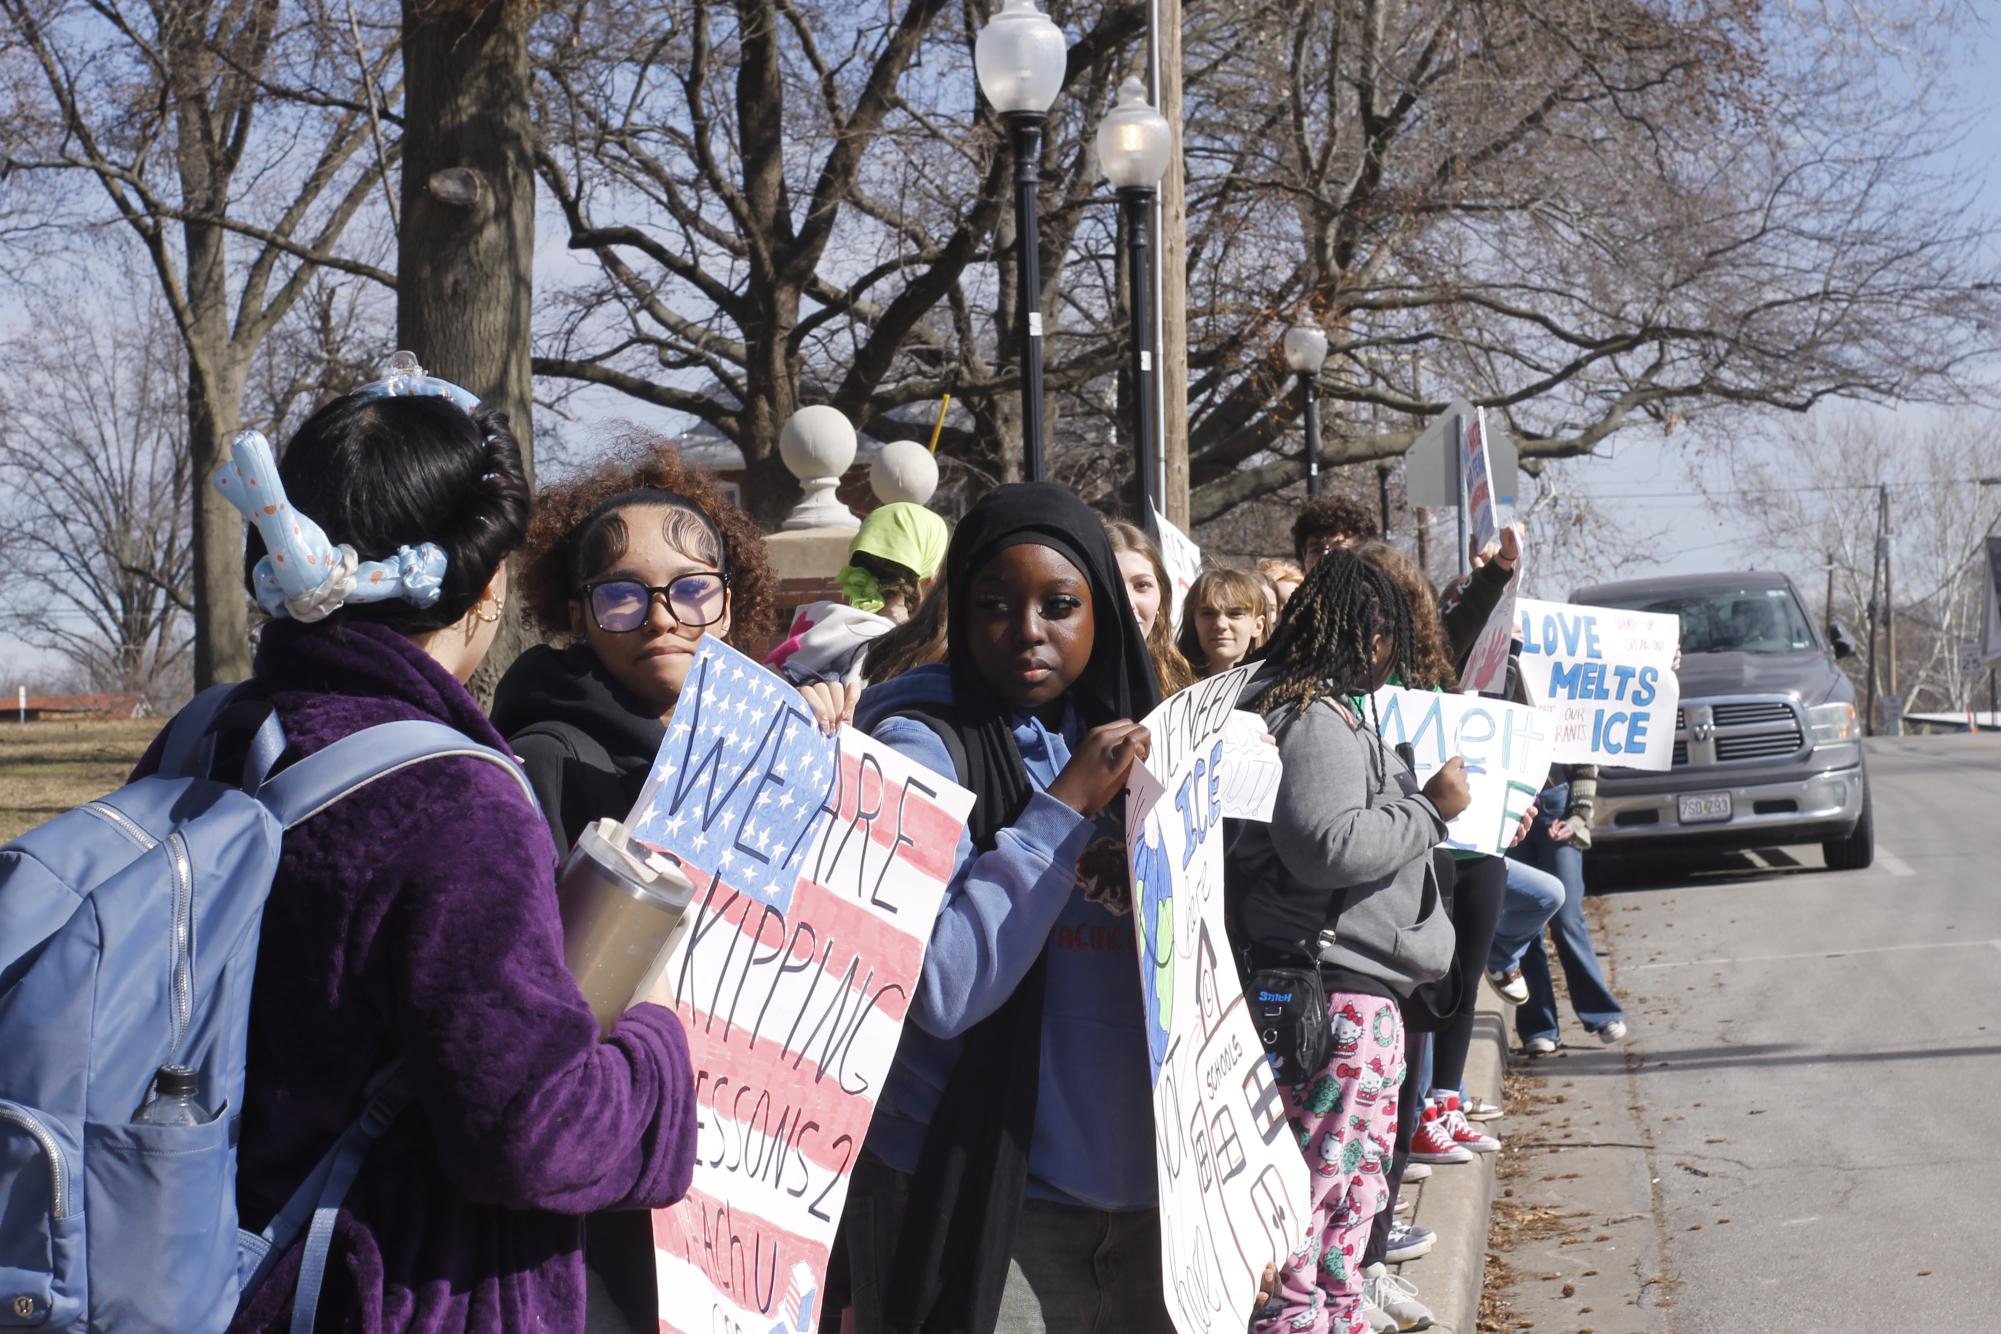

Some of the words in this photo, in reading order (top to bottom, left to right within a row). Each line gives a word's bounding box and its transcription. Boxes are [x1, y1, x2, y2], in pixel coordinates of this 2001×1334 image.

[1520, 609, 1602, 658] LOVE
[1962, 658, 1981, 671] 25
[1180, 667, 1249, 761] NEED
[1549, 661, 1659, 706] MELTS
[1564, 707, 1585, 721] OUR
[1376, 692, 1545, 774] Melt
[1555, 725, 1587, 743] RANTS
[1591, 709, 1651, 755] ICE
[668, 656, 812, 866] WE
[781, 737, 938, 915] ARE
[1174, 739, 1224, 872] ICE
[658, 852, 906, 1096] KIPPING
[1206, 1033, 1243, 1100] SCHOOLS
[807, 1134, 853, 1223] 2
[754, 1231, 778, 1314] U
